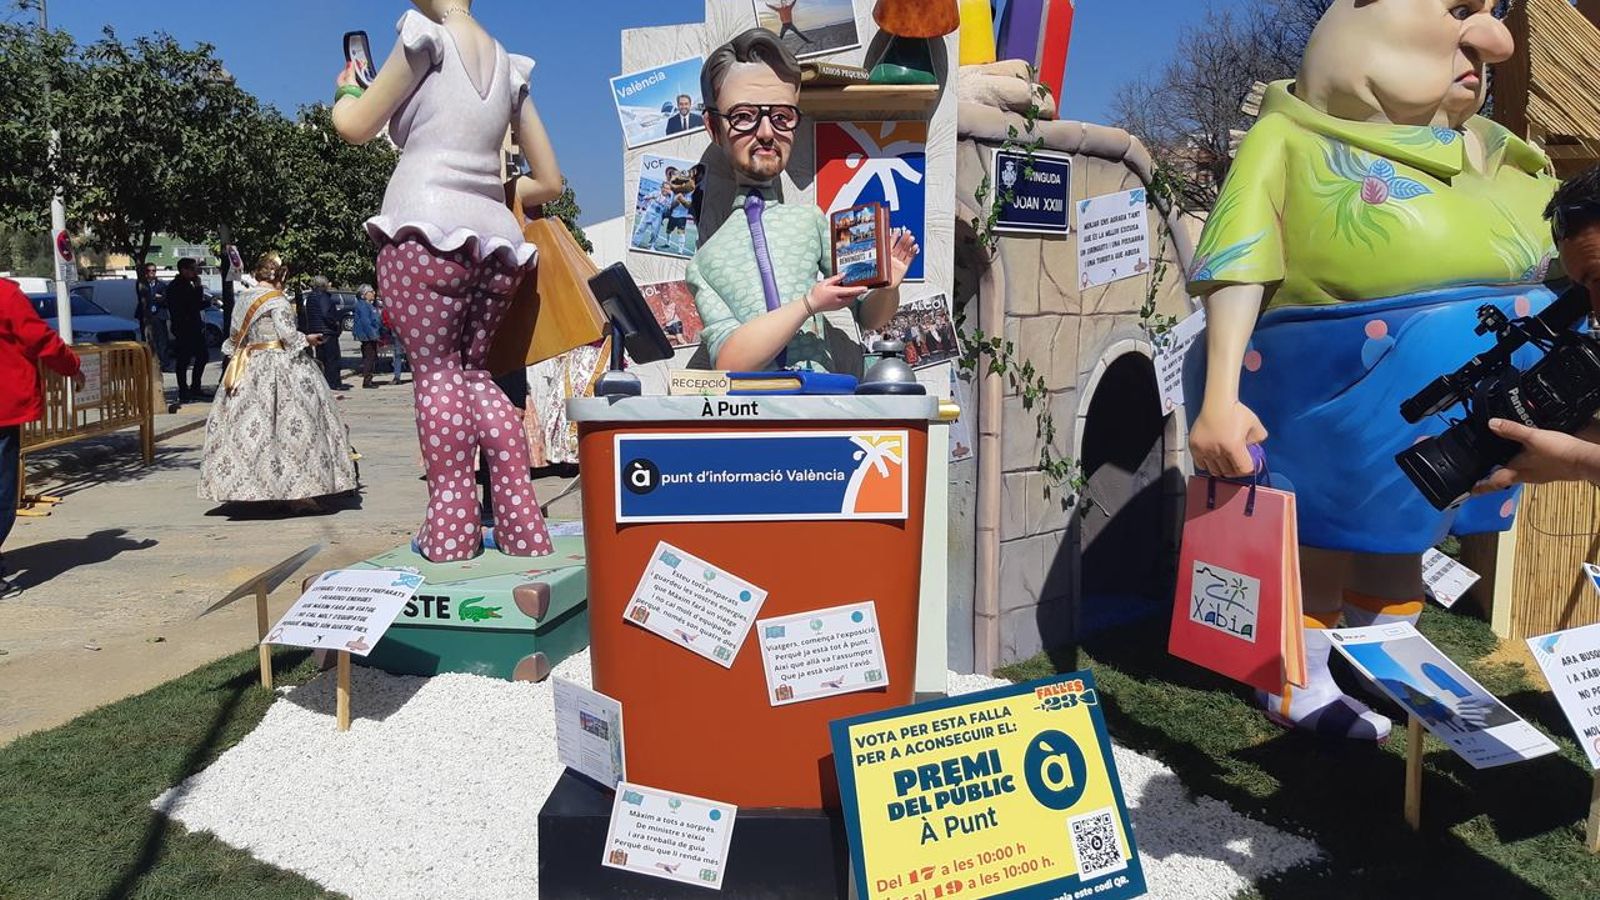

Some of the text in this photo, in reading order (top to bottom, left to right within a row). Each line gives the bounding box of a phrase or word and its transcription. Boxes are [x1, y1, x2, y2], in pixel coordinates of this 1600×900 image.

[617, 71, 666, 98] València
[643, 160, 665, 171] VCF
[1024, 171, 1061, 185] INGUDA
[1013, 195, 1064, 212] JOAN XXIII
[671, 377, 727, 389] RECEPCIÓ
[702, 397, 759, 417] À Punt
[1508, 387, 1538, 429] Panaso
[631, 462, 845, 487] à punt d'informació València
[370, 587, 407, 598] PREPARATS
[653, 573, 718, 607] guardeu les vostres
[672, 570, 738, 607] Esteu tots preparats
[653, 584, 667, 594] que
[706, 609, 716, 618] un
[716, 614, 737, 628] viatge
[655, 595, 665, 603] no
[665, 601, 676, 610] cal
[676, 606, 692, 617] molt
[693, 613, 732, 636] d'equipatge
[1193, 594, 1253, 638] Xàbia
[663, 610, 685, 625] només
[700, 626, 722, 642] quatre
[722, 638, 737, 650] dies
[836, 627, 876, 640] l'exposició
[790, 662, 804, 671] que
[832, 649, 873, 661] l'assumpte
[804, 649, 811, 658] ja
[812, 646, 828, 655] està
[1561, 655, 1580, 667] ARA
[780, 673, 796, 682] Que
[798, 671, 805, 681] ja
[807, 668, 823, 676] està
[824, 664, 848, 673] volant
[1566, 674, 1572, 684] I
[1573, 673, 1580, 682] A
[1035, 679, 1084, 700] FALLES
[1578, 689, 1591, 699] NO
[1587, 707, 1593, 717] I
[855, 705, 1012, 748] VOTA PER ESTA FALLA
[856, 722, 1018, 766] PER A ACONSEGUIR EL:
[893, 749, 1003, 797] PREMI
[1038, 740, 1074, 792] à
[887, 775, 1016, 821] DEL PÚBLIC
[636, 821, 647, 830] De
[648, 824, 680, 836] ministre
[663, 817, 679, 826] tots
[920, 806, 998, 845] À Punt
[632, 832, 646, 840] ara
[646, 834, 677, 846] treballa
[678, 840, 688, 848] de
[643, 843, 655, 852] diu
[656, 846, 672, 856] que
[679, 852, 702, 862] renda
[877, 843, 1026, 893] Del 17 a les 10:00 h
[933, 880, 963, 898] 19
[968, 879, 977, 889] a
[980, 872, 1000, 886] les
[1002, 859, 1038, 879] 10:00
[1042, 856, 1055, 868] h.
[1074, 888, 1093, 899] este
[1094, 878, 1113, 893] codi
